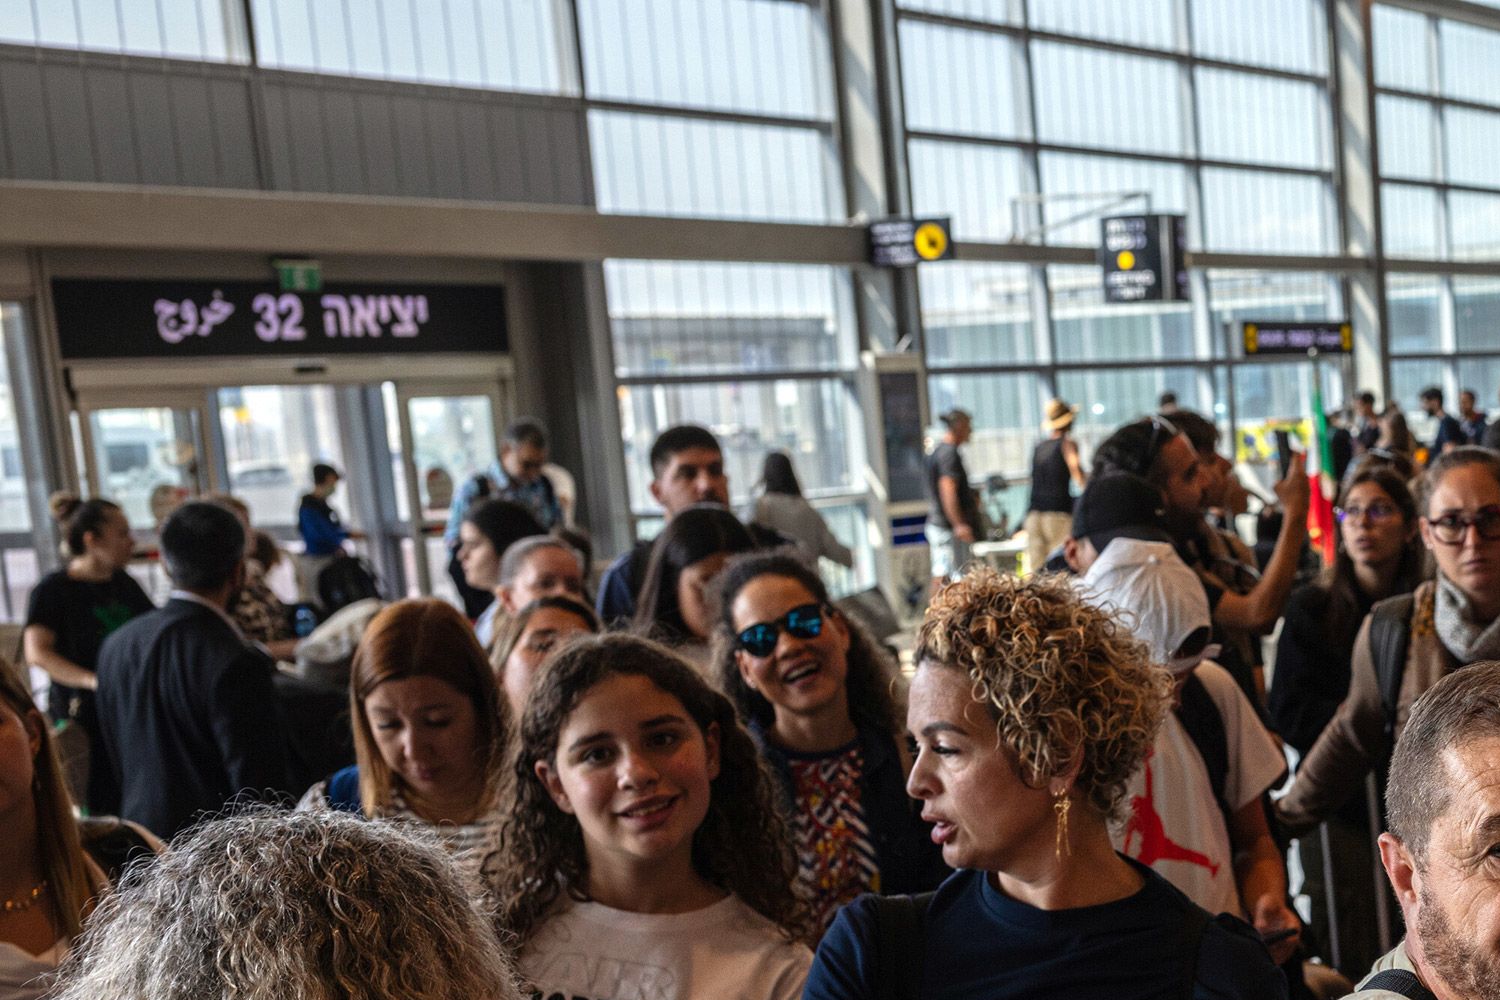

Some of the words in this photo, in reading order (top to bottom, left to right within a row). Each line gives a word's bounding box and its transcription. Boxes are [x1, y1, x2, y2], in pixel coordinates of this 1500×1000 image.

[153, 289, 235, 344] خروج
[252, 293, 307, 342] 32
[321, 295, 429, 338] יציאה
